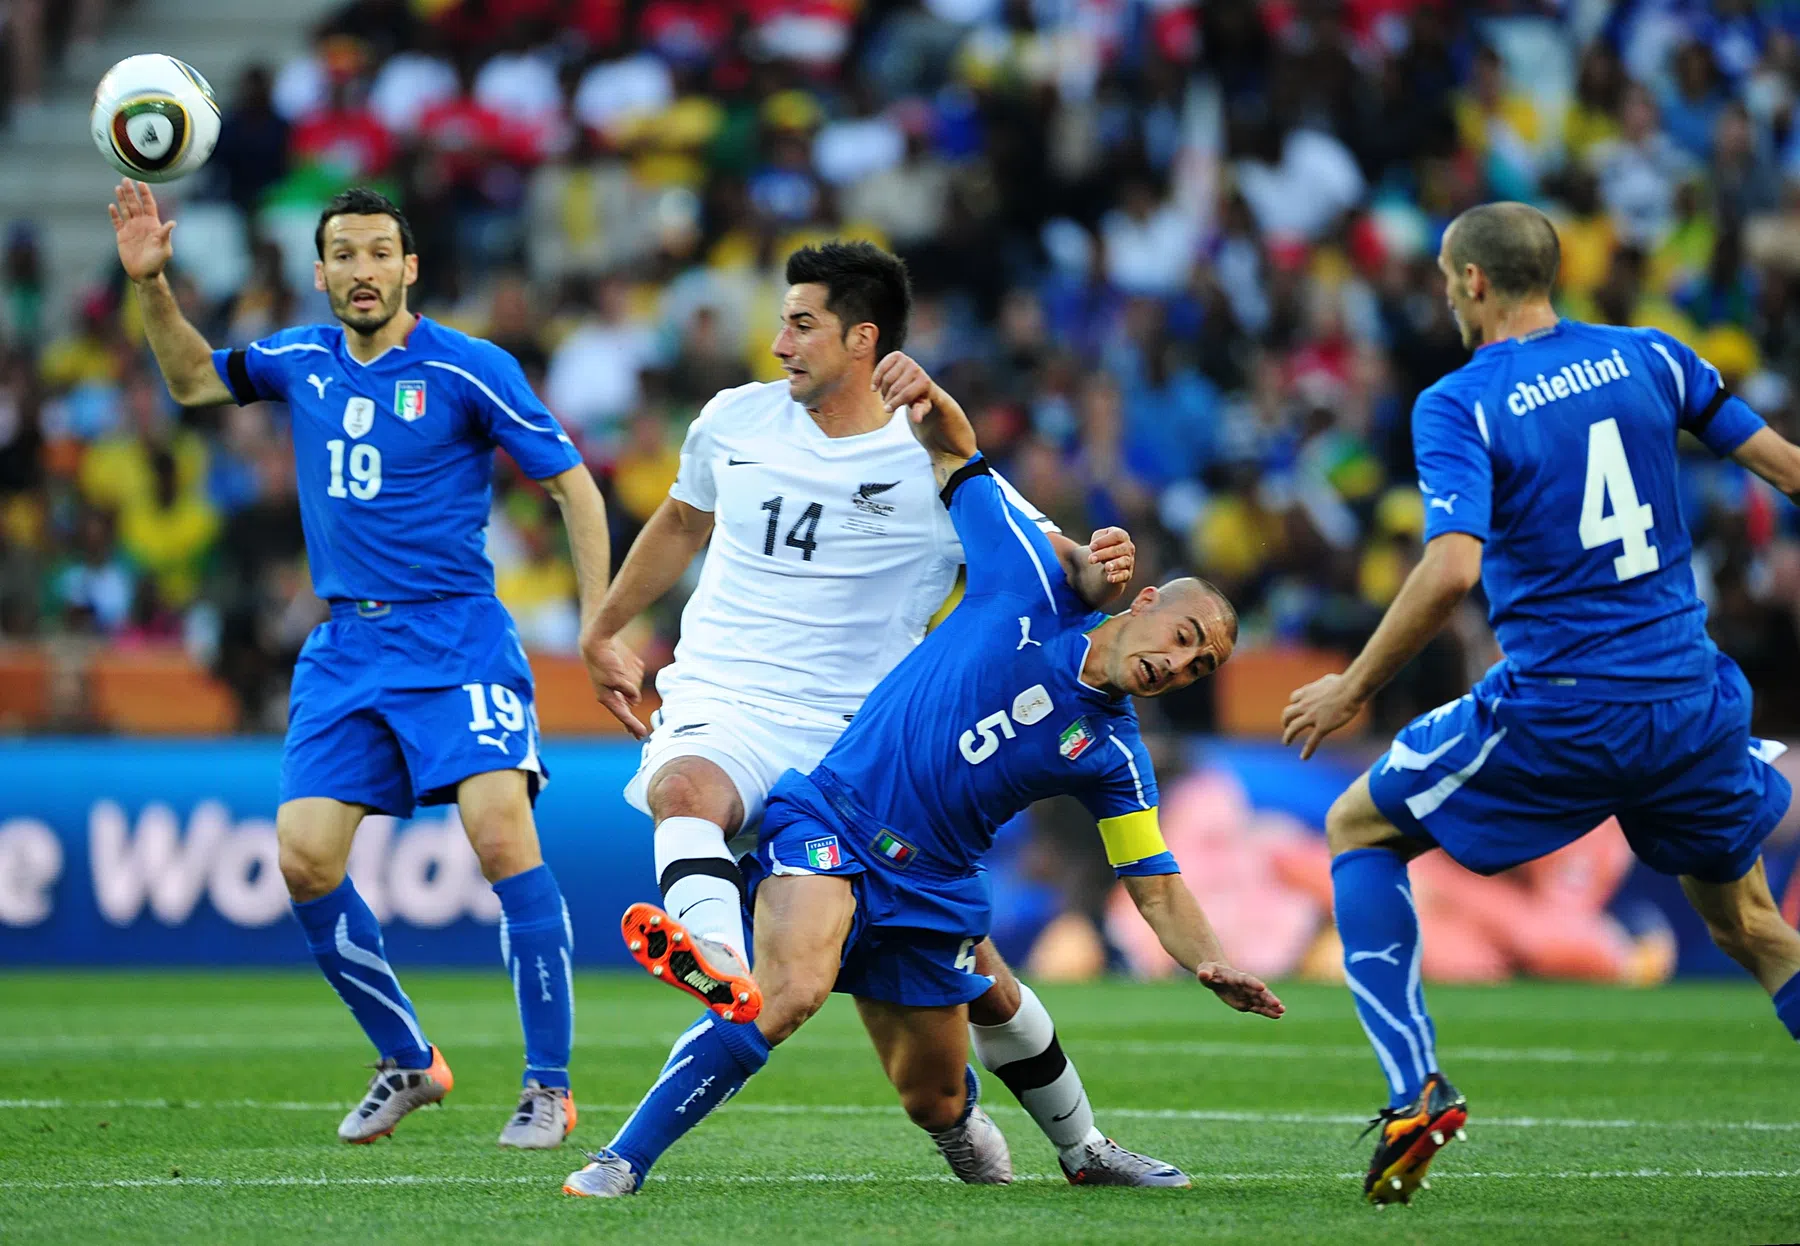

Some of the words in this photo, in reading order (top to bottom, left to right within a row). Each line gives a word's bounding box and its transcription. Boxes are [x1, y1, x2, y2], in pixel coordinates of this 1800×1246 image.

[1507, 348, 1630, 416] chiellini
[326, 439, 382, 500] 19
[1578, 417, 1659, 581] 4
[761, 496, 823, 562] 14
[462, 683, 525, 732] 19
[958, 709, 1016, 765] 5
[810, 840, 834, 849] ITALIA
[683, 969, 719, 994] NIKE
